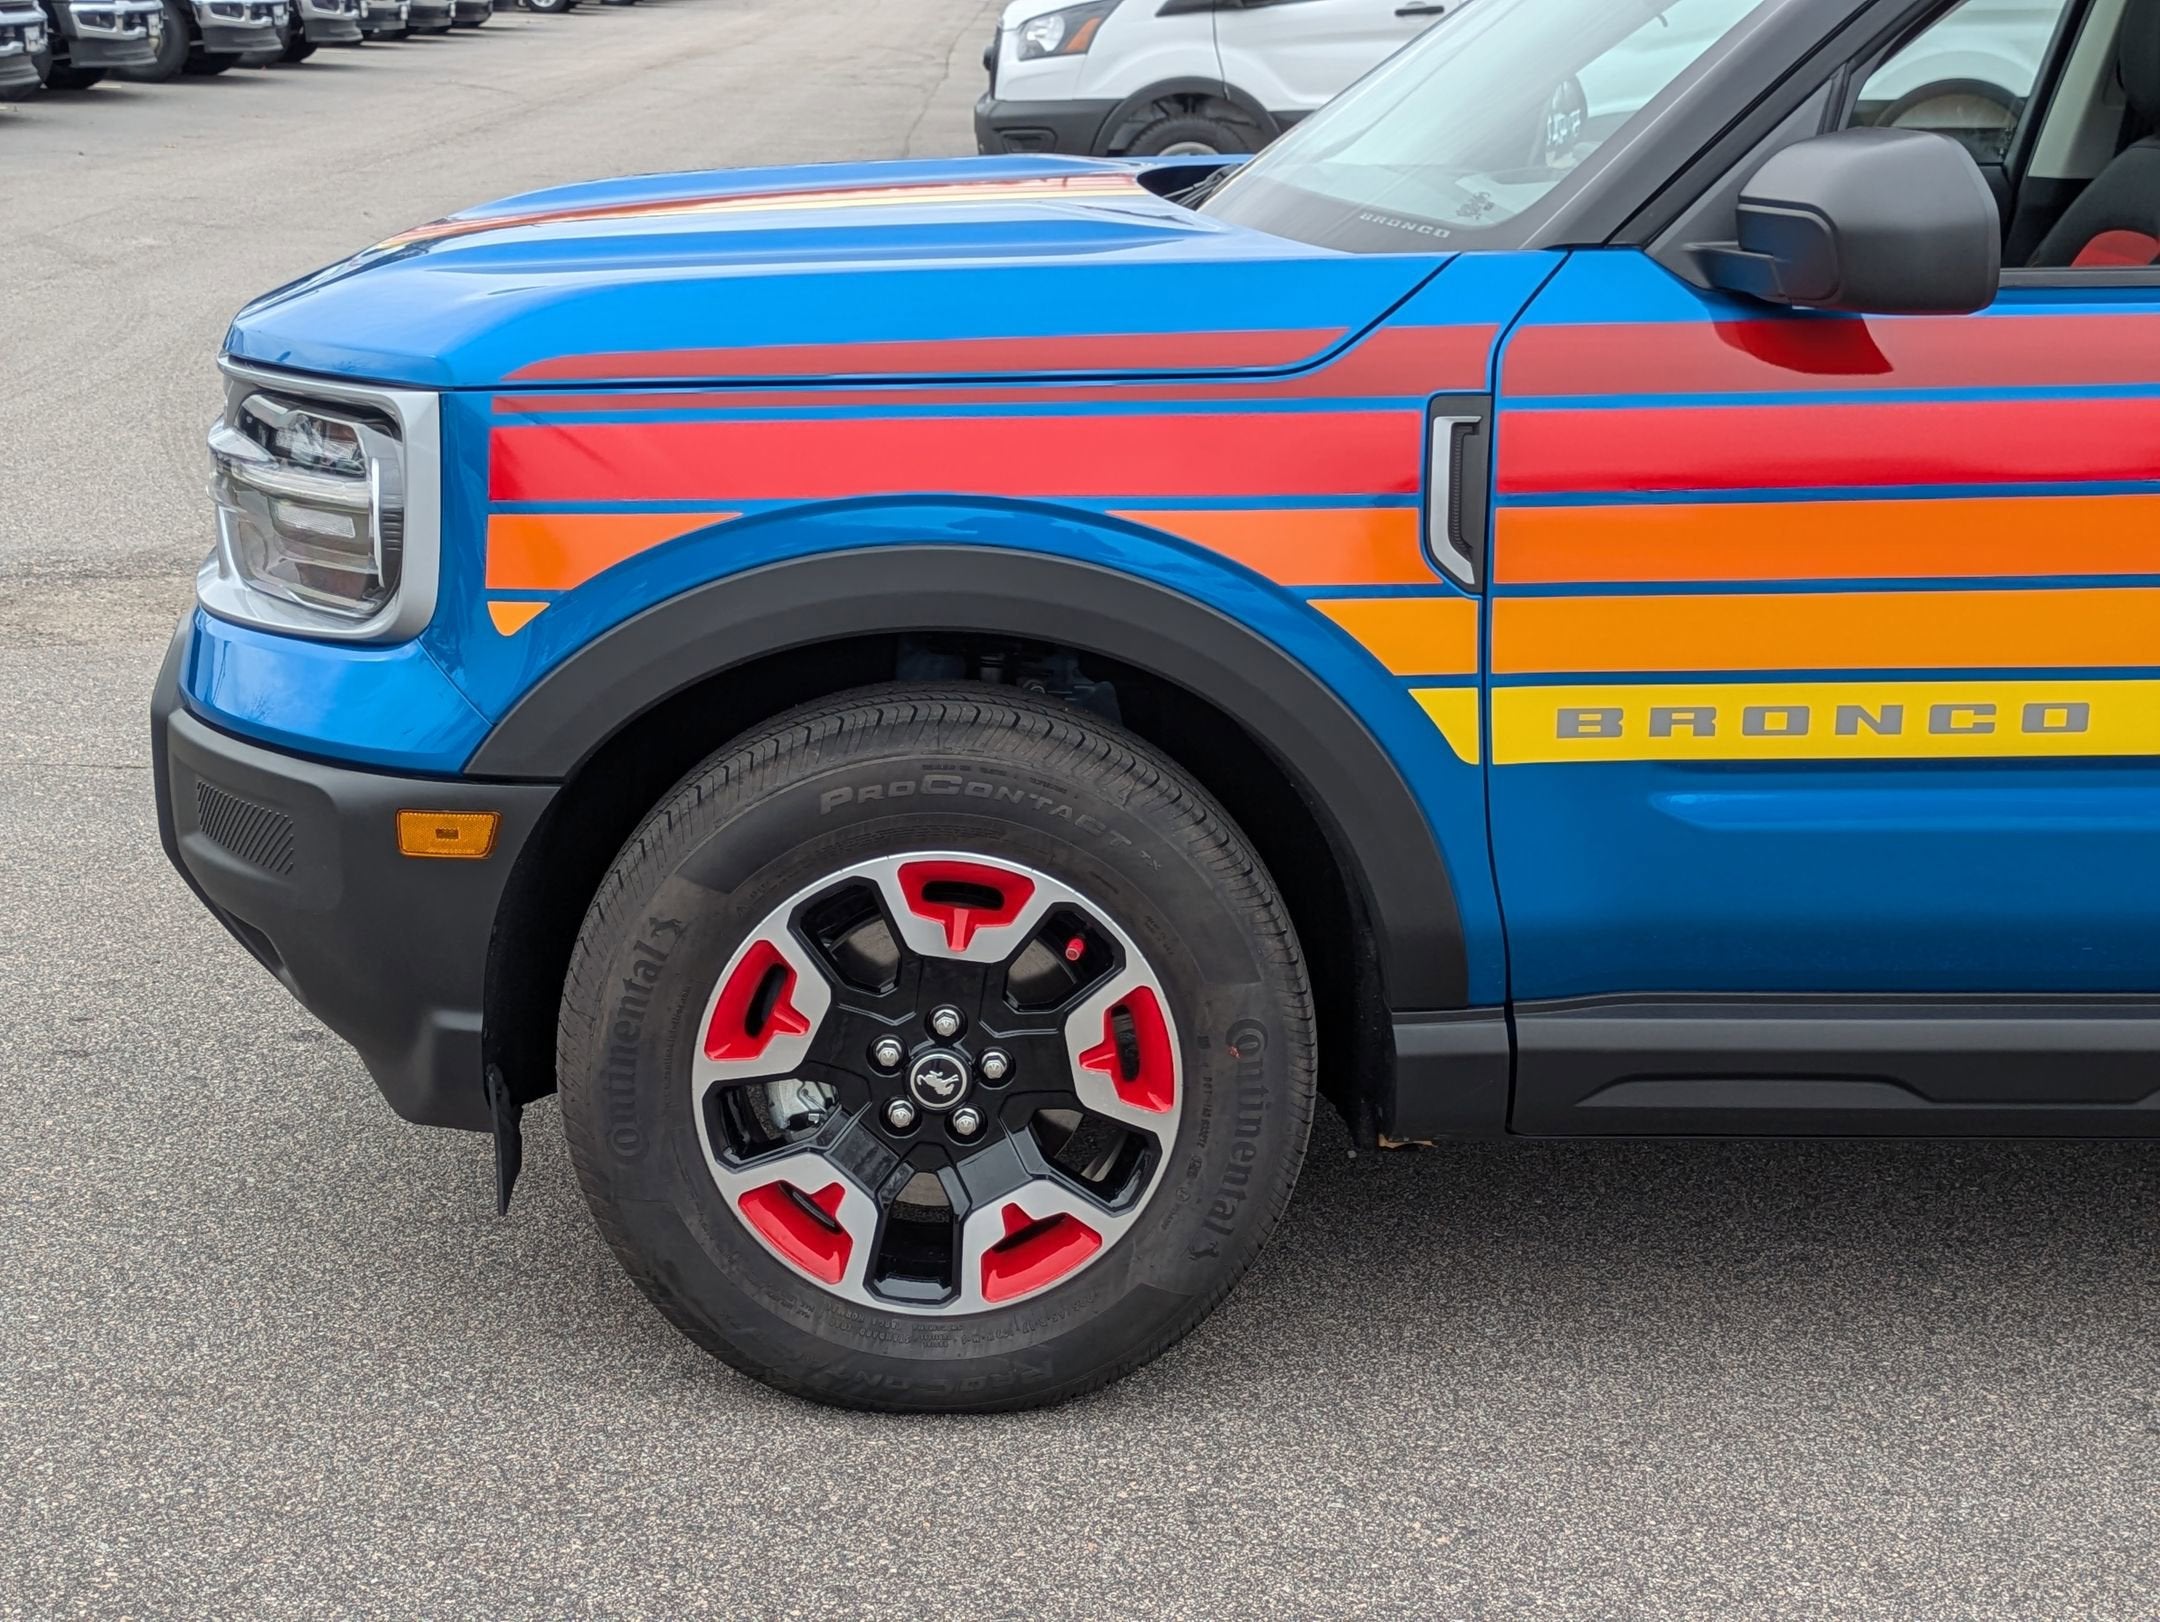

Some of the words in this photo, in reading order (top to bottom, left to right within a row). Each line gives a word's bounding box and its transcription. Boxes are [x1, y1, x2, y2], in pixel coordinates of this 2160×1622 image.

[1359, 211, 1451, 239] BRONCO
[1555, 702, 2090, 739] BRONCO
[606, 939, 669, 1163] Continental
[1200, 1018, 1270, 1236] Continental
